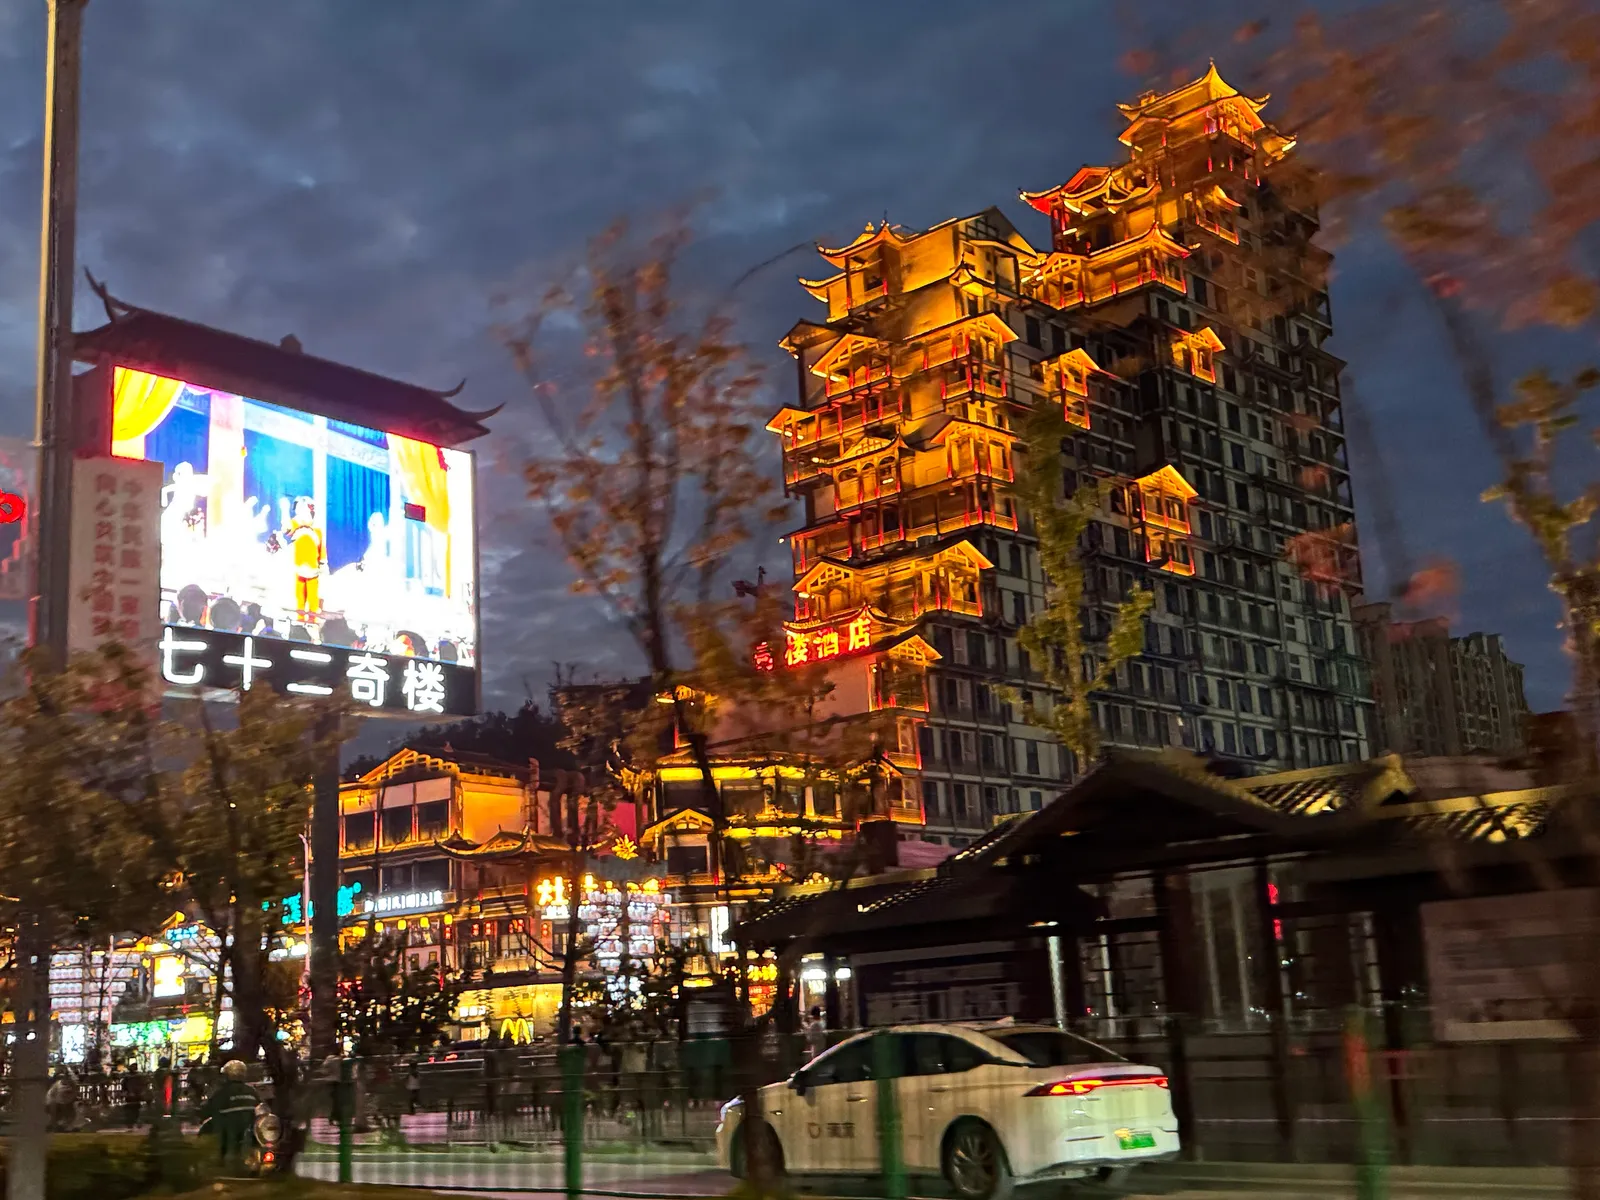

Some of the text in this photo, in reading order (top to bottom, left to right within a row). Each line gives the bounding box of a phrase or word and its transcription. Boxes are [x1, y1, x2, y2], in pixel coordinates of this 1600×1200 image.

[159, 625, 446, 714] 七十二奇楼
